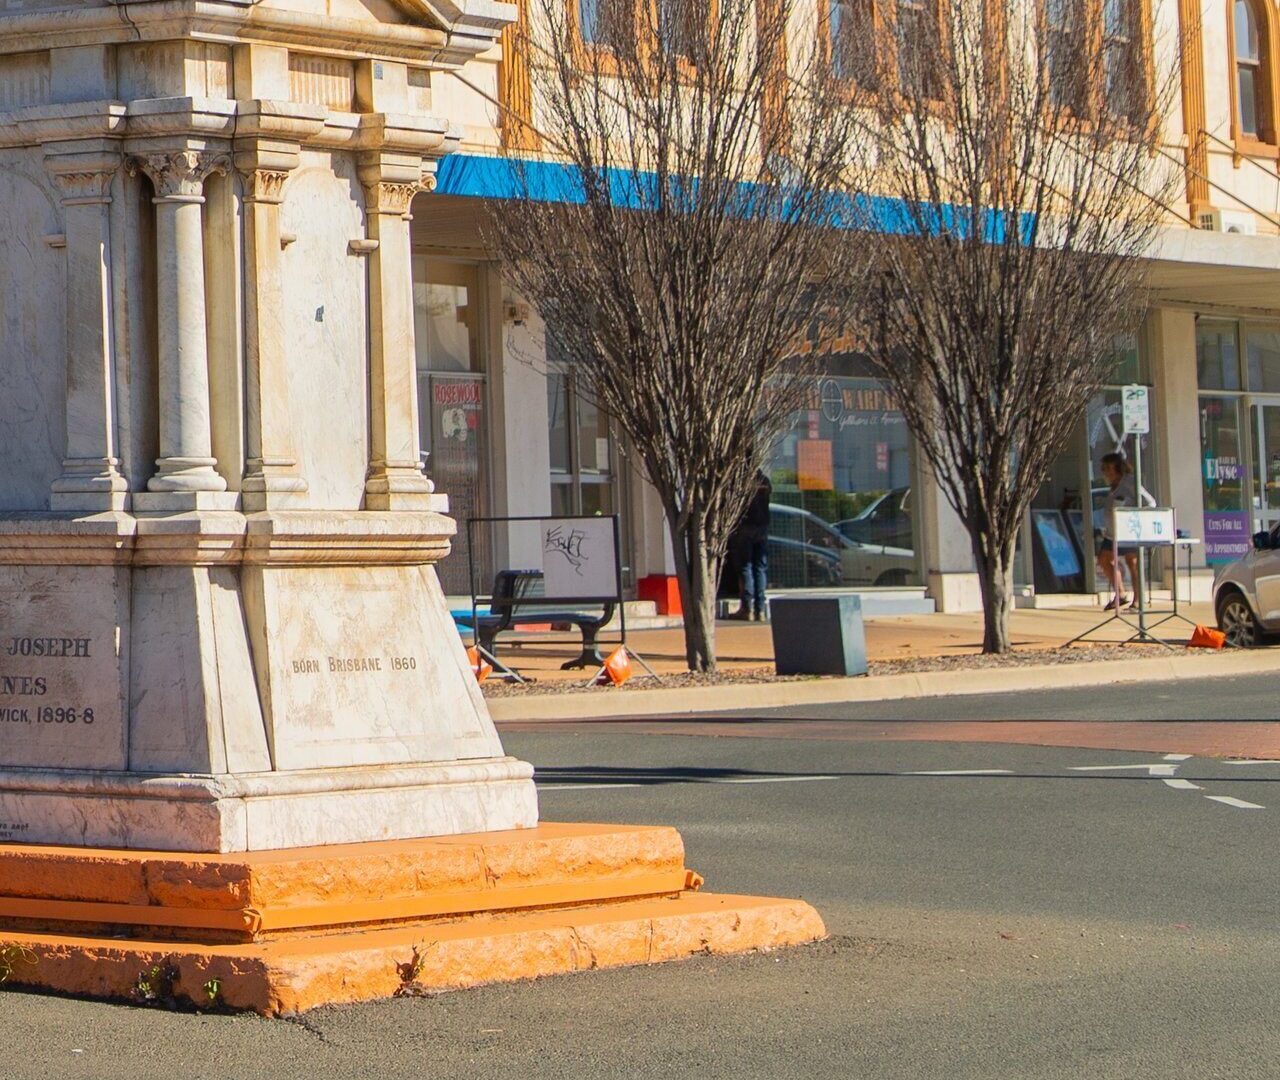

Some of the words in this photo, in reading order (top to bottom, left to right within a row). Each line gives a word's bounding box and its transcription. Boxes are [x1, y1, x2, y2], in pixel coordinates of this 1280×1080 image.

[434, 383, 481, 404] ROSEWOOL
[1125, 389, 1146, 400] 2P
[1206, 458, 1238, 487] Elyse
[7, 636, 92, 658] JOSEPH
[292, 659, 320, 674] BORN
[390, 656, 417, 671] 1860
[37, 705, 95, 725] 1896-8
